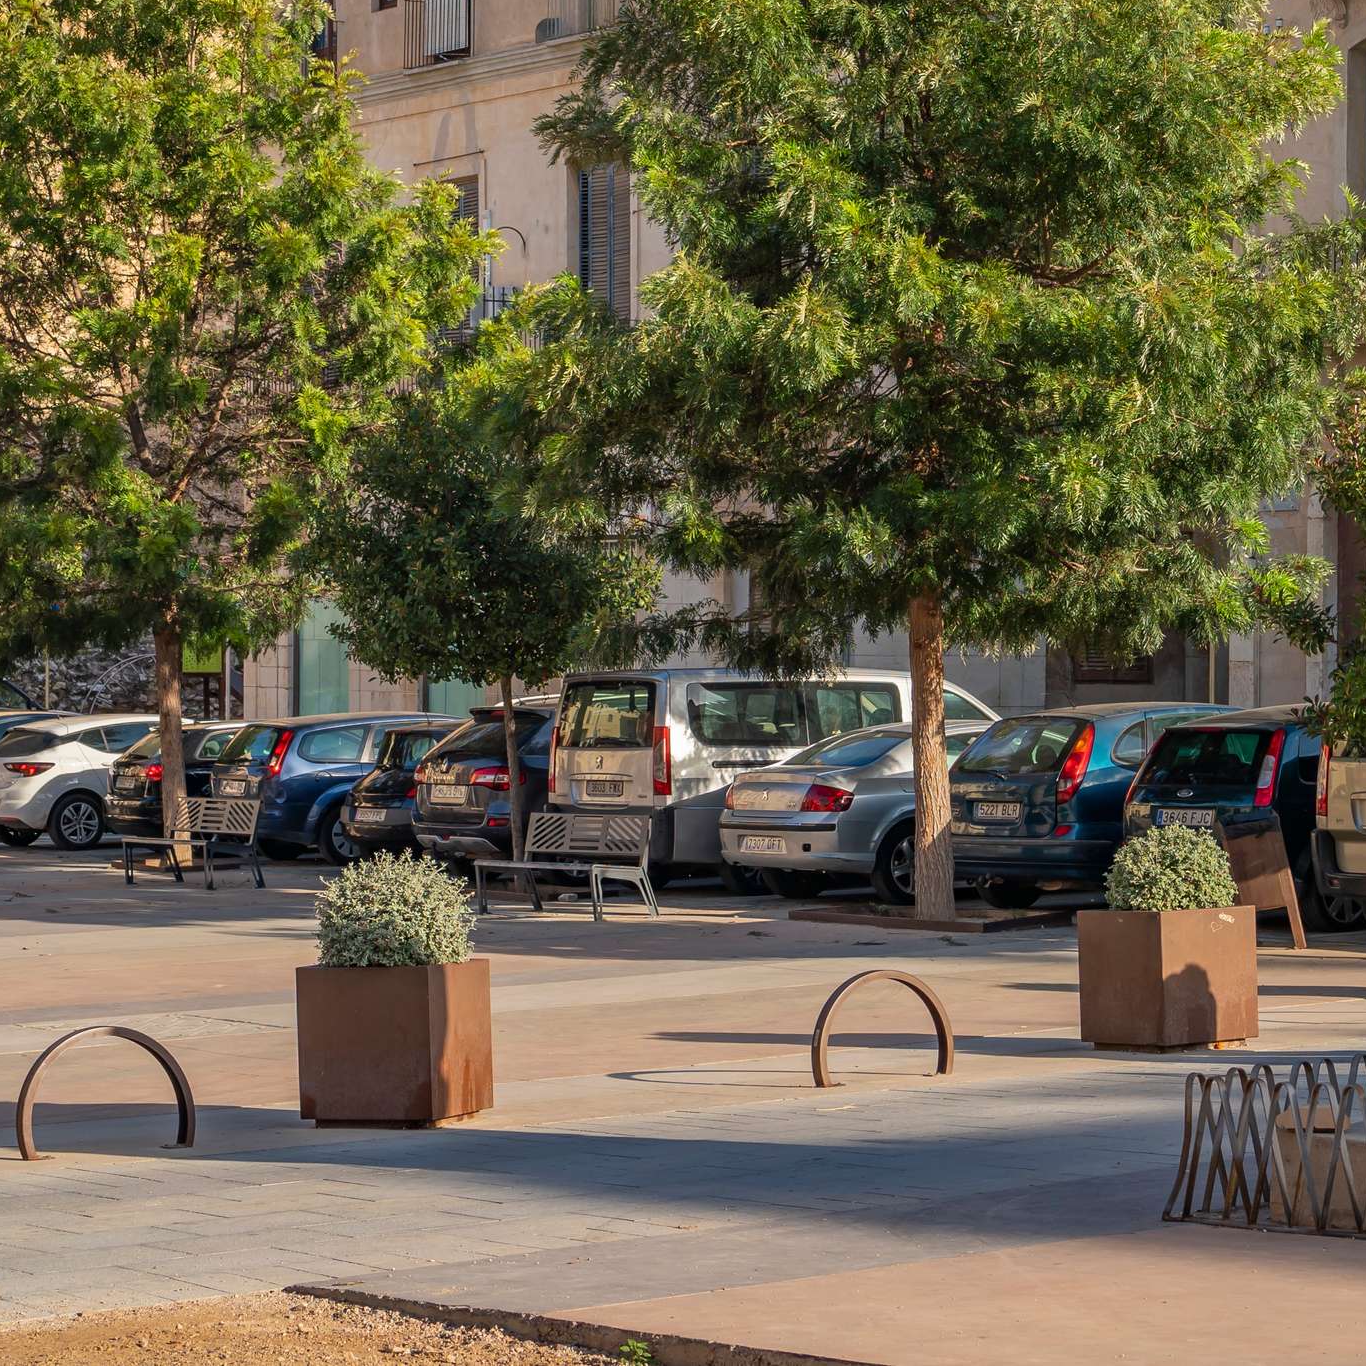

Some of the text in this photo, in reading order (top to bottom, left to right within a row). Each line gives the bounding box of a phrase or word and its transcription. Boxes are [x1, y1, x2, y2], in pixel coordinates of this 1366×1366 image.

[979, 804, 1018, 816] 5221 BLR
[1163, 811, 1211, 824] 3646 FJC
